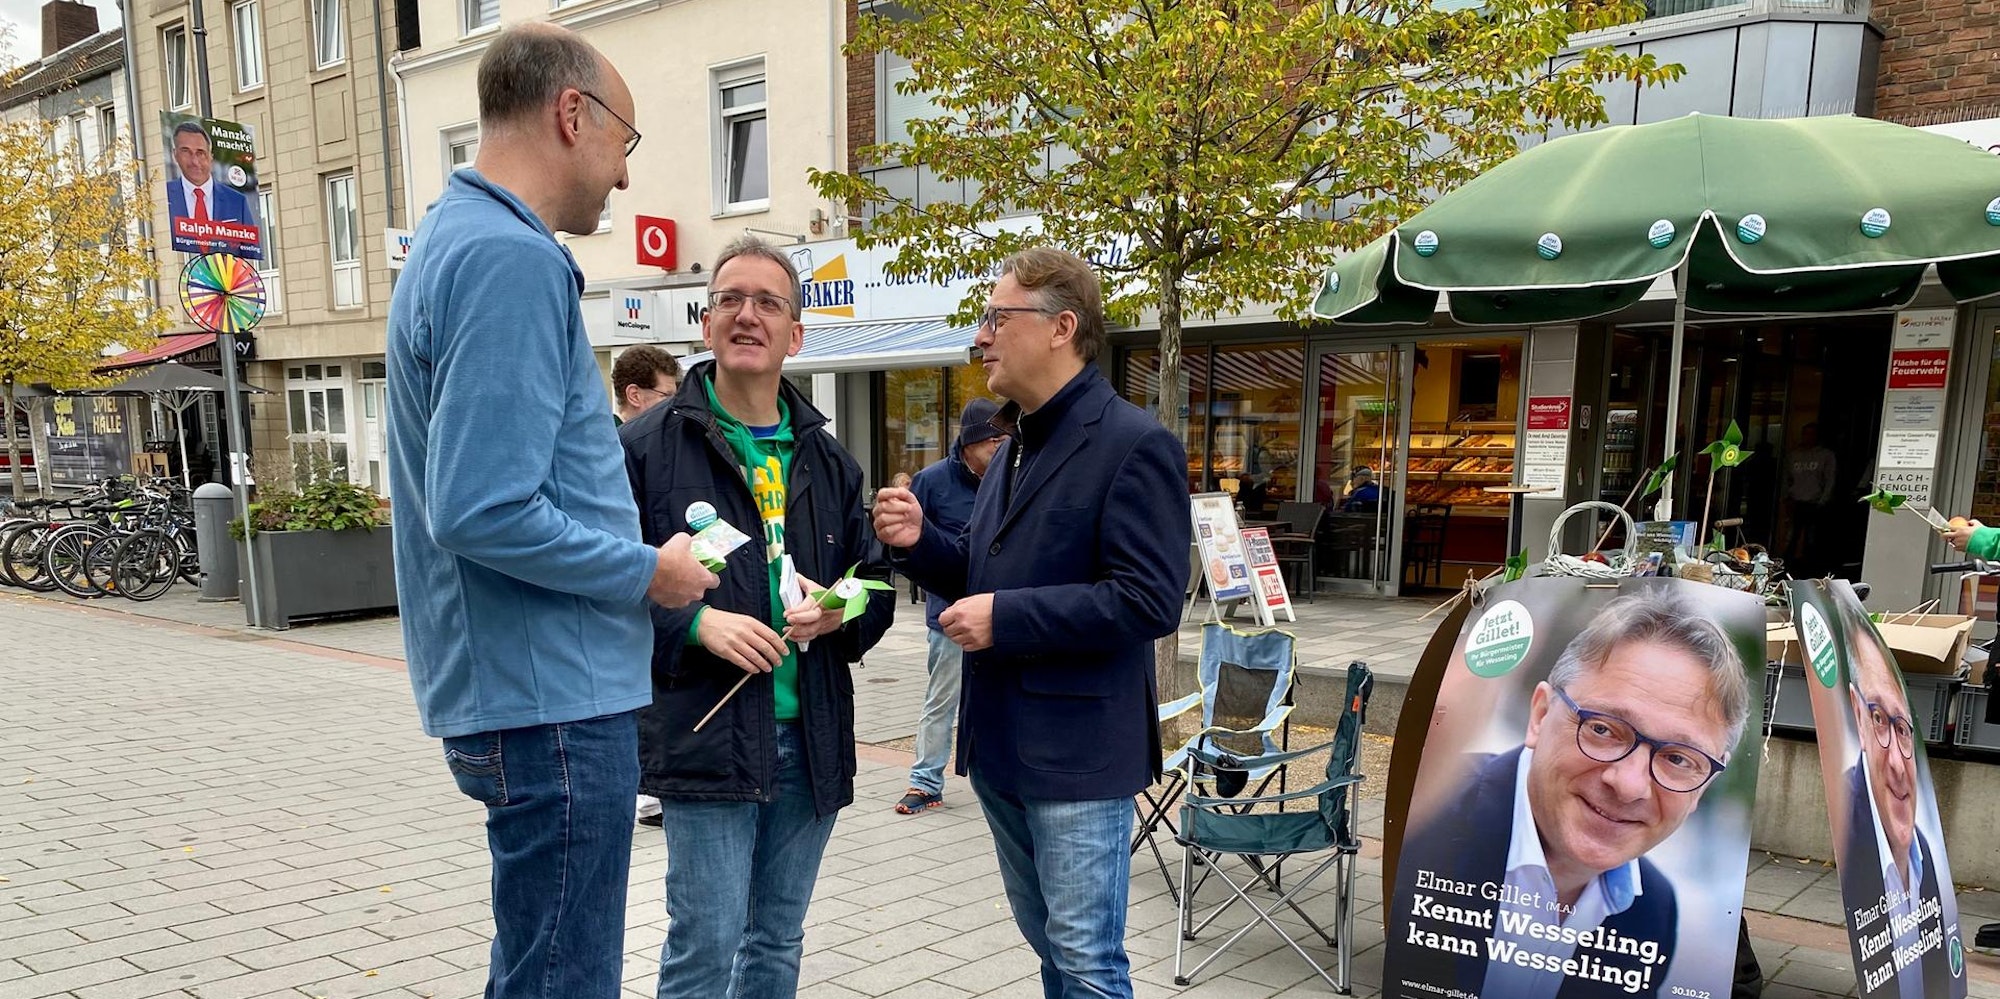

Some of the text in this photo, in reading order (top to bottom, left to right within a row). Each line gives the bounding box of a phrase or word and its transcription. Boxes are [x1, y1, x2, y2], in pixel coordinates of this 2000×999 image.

[211, 126, 252, 142] Manzke
[217, 140, 253, 153] macht's!
[179, 221, 256, 240] Ralph Manzke
[175, 237, 218, 247] Bürgermeister
[618, 321, 651, 330] NetCologne
[234, 342, 250, 355] ky
[1892, 366, 1945, 375] Feuerwehr
[1933, 358, 1946, 366] die
[93, 396, 118, 413] SPIEL
[93, 414, 122, 435] HALLE
[1880, 473, 1930, 482] FLACH-
[1484, 610, 1513, 631] Jetzt
[1476, 621, 1519, 644] Gillet!
[1480, 643, 1524, 658] Bürgermeister
[1486, 653, 1517, 665] Wesseling
[1416, 870, 1577, 916] Elmar Gillet (M.A.)
[1854, 907, 1880, 931] Elmar
[1879, 890, 1901, 915] Gillet
[1411, 894, 1667, 965] Kennt Wesseling,
[1858, 896, 1941, 962] Kennt Wesseling,
[1406, 922, 1652, 993] kann Wesseling!
[1863, 919, 1944, 994] kann Wesseling!
[1401, 979, 1478, 999] www.elmar-gillet.de
[1671, 985, 1711, 999] 30.10.22
